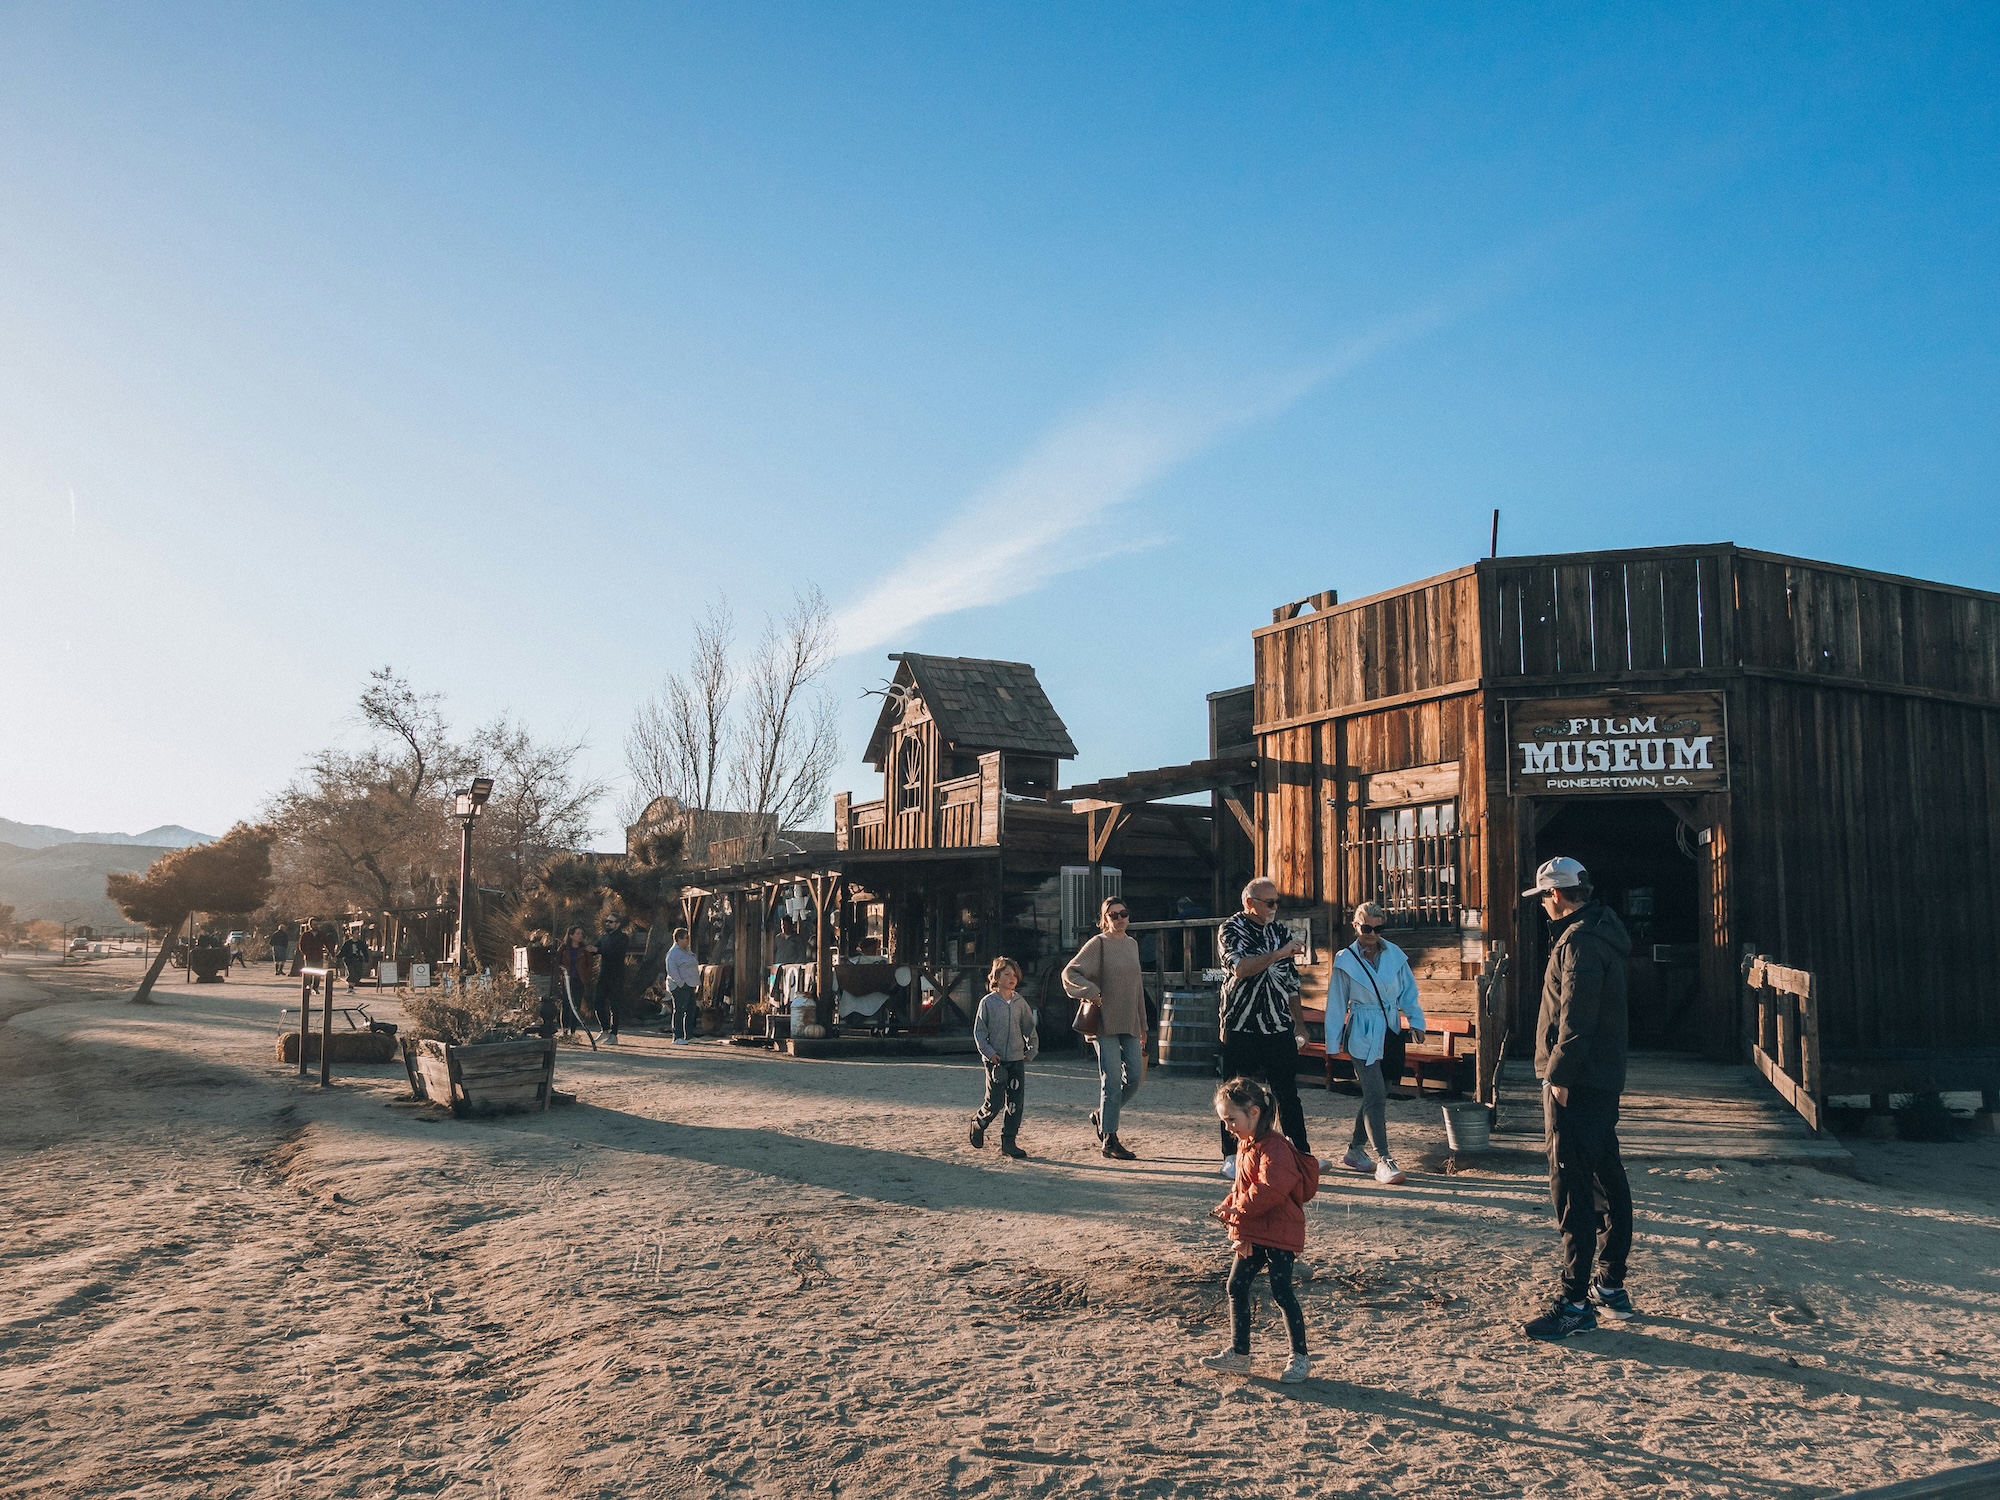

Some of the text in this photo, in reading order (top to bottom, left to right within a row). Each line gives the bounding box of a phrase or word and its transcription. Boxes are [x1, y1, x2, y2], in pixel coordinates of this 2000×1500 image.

[1569, 716, 1657, 735] FILM
[1519, 736, 1713, 774] MUSEUM
[1547, 776, 1693, 789] PIONEERTOWN, CA.
